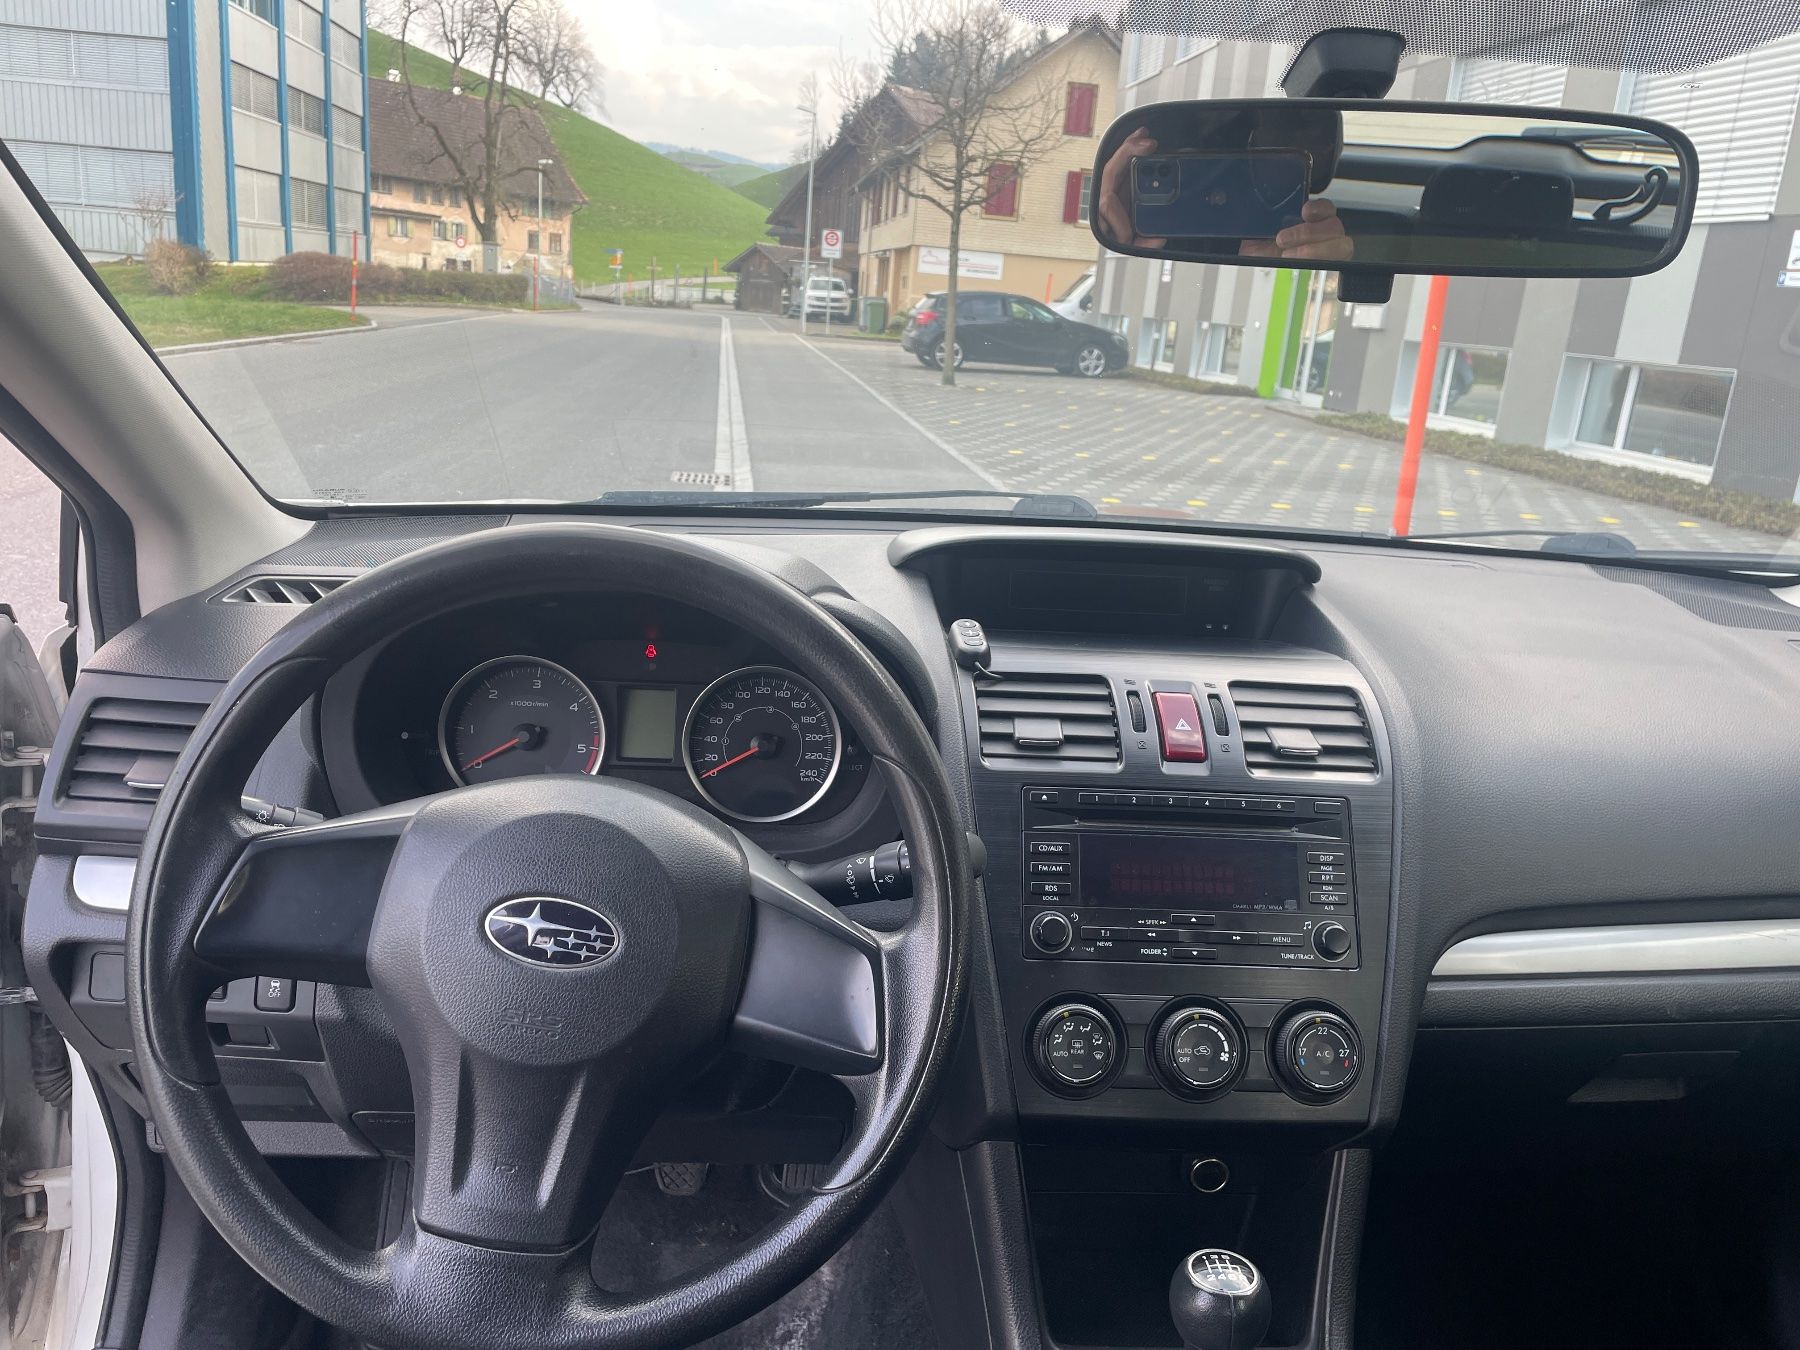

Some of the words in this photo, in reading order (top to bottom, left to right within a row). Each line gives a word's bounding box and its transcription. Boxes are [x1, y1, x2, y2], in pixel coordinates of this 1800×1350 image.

[532, 680, 541, 689] 3
[488, 689, 498, 699] 2
[735, 691, 751, 699] 100
[569, 703, 579, 712] 4
[791, 701, 807, 709] 160
[801, 716, 817, 724] 180
[703, 735, 718, 743] 40
[805, 733, 824, 741] 200
[577, 744, 587, 753] 5
[805, 752, 823, 760] 220
[473, 760, 482, 769] 0
[799, 769, 818, 777] 240
[1131, 796, 1137, 804] 2
[1038, 844, 1063, 852] CD/AUX
[1319, 854, 1334, 862] DISP
[1038, 864, 1063, 872] FM/AM
[1044, 884, 1058, 892] RDS
[1320, 894, 1339, 902] SCAN
[1280, 953, 1315, 961] TUNE/TRACK
[1317, 1026, 1328, 1035] 22
[1298, 1047, 1307, 1056] 17
[1316, 1050, 1331, 1058] A/C
[1338, 1048, 1350, 1057] 27
[1217, 1273, 1227, 1281] 4
